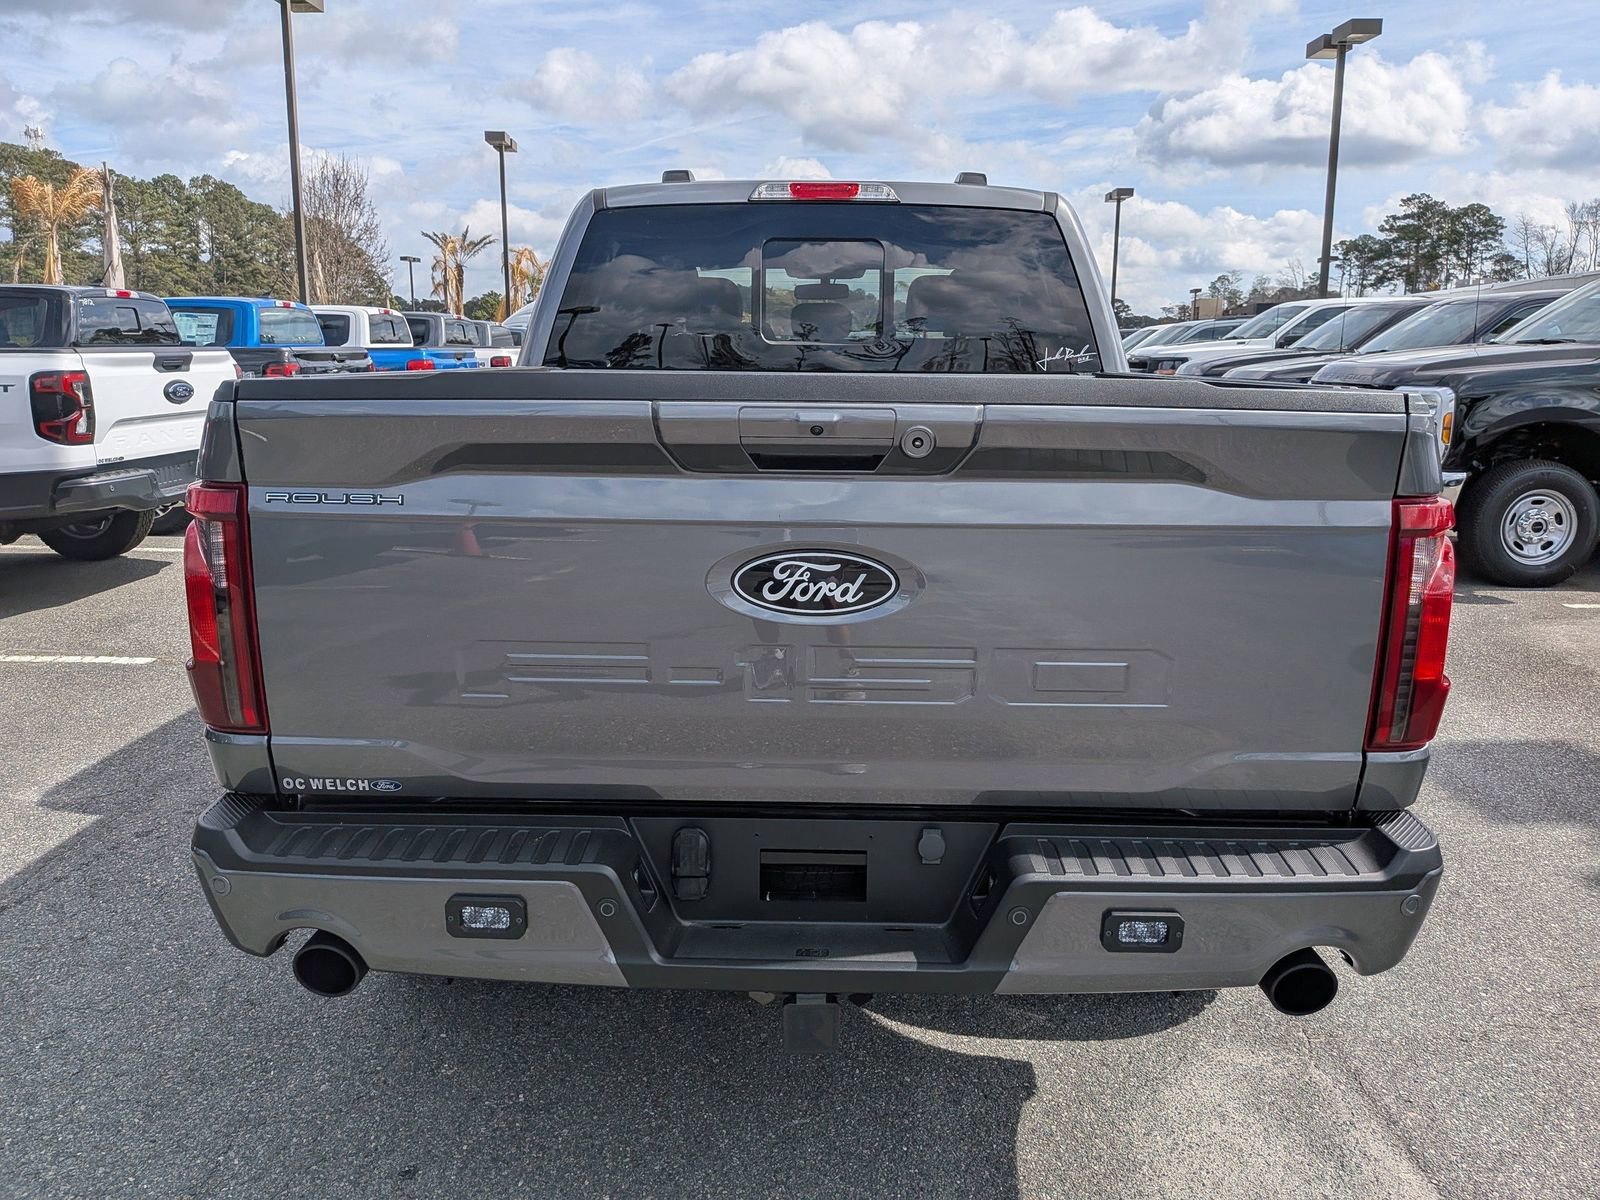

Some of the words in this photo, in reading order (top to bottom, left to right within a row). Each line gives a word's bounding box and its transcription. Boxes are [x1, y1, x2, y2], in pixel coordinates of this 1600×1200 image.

[264, 492, 404, 505] ROUSH
[762, 560, 868, 603] Ford
[456, 639, 1173, 708] F-150
[282, 777, 306, 790] OC
[308, 778, 370, 791] WELCH
[376, 781, 396, 790] Ford
